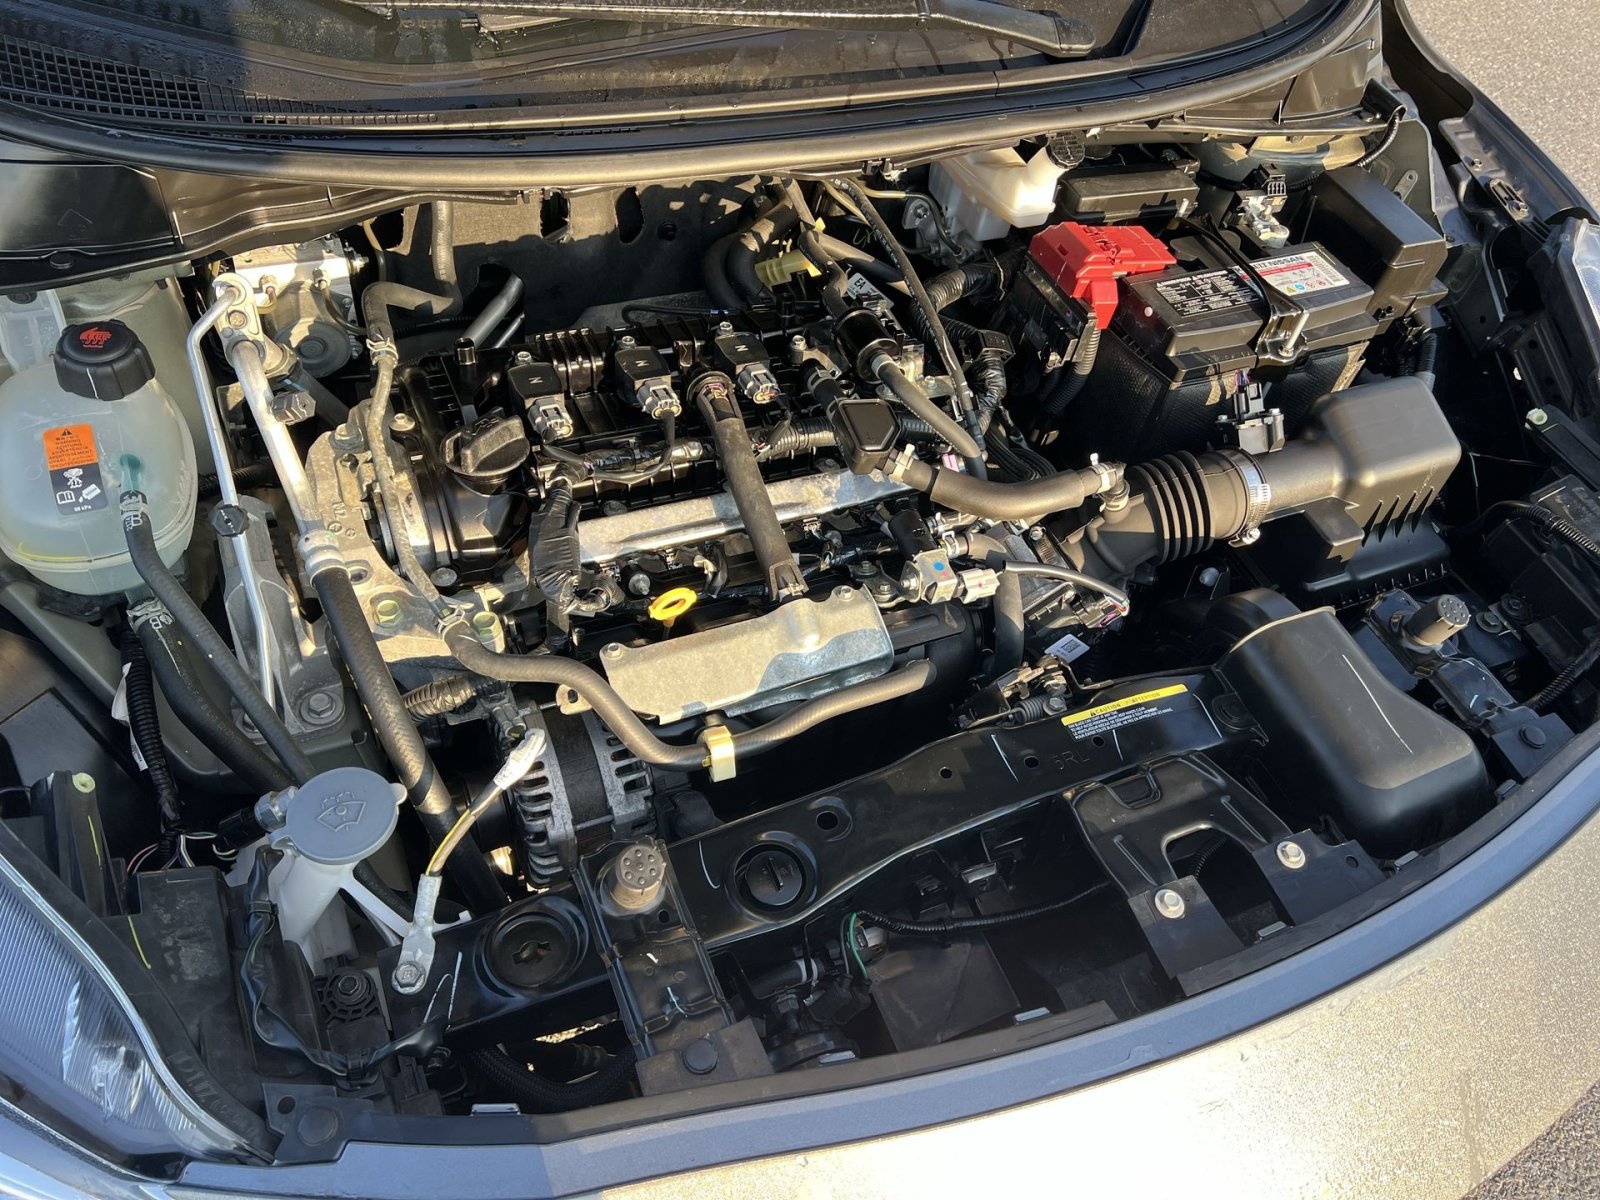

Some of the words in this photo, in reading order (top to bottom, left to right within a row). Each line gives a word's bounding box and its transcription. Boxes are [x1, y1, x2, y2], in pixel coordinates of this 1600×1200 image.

[1269, 256, 1304, 266] NISSAN
[854, 277, 866, 289] EA
[1095, 703, 1121, 714] CAUTION
[1131, 692, 1160, 704] ATTENTION
